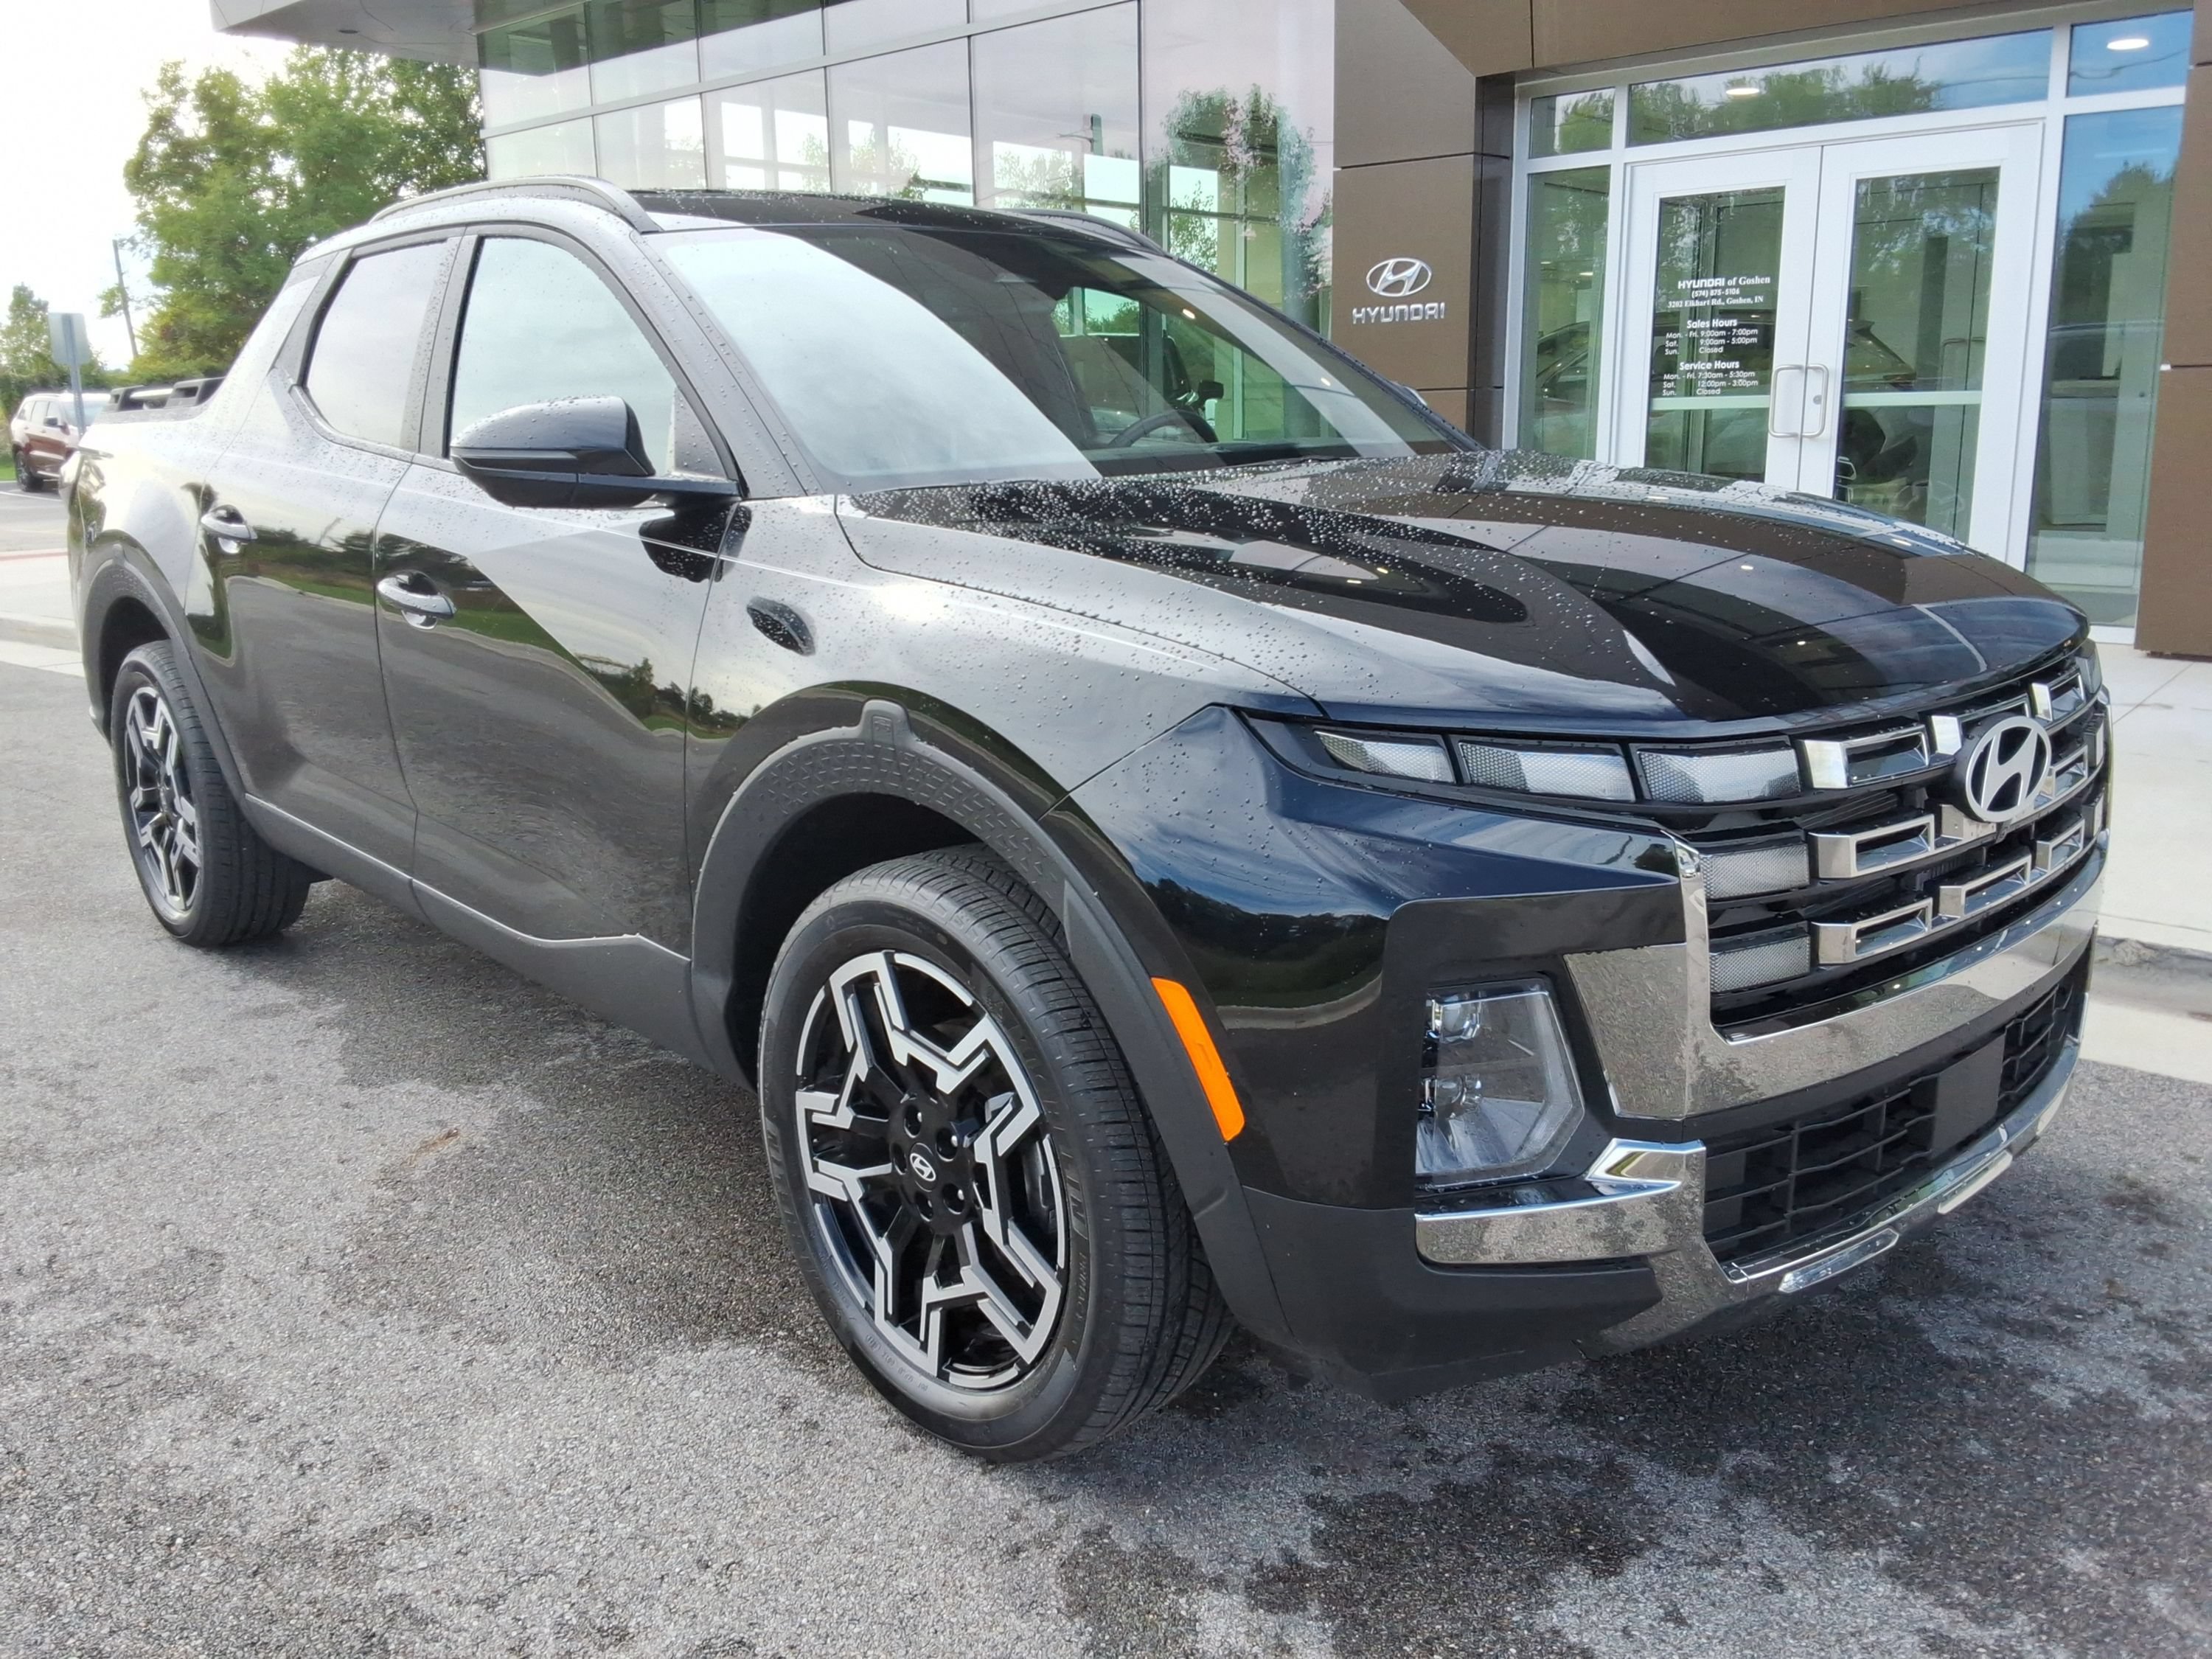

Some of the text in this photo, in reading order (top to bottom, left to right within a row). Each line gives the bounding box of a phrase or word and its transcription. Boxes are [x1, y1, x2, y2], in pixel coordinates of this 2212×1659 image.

[1678, 276, 1770, 289] HYUNDAI of Goshen
[1691, 290, 1708, 298] (574)
[1685, 299, 1709, 307] Elkhart
[1352, 302, 1445, 324] HYUNDAI
[1687, 319, 1737, 328] Sales Hours
[1680, 361, 1739, 370] Service Hours
